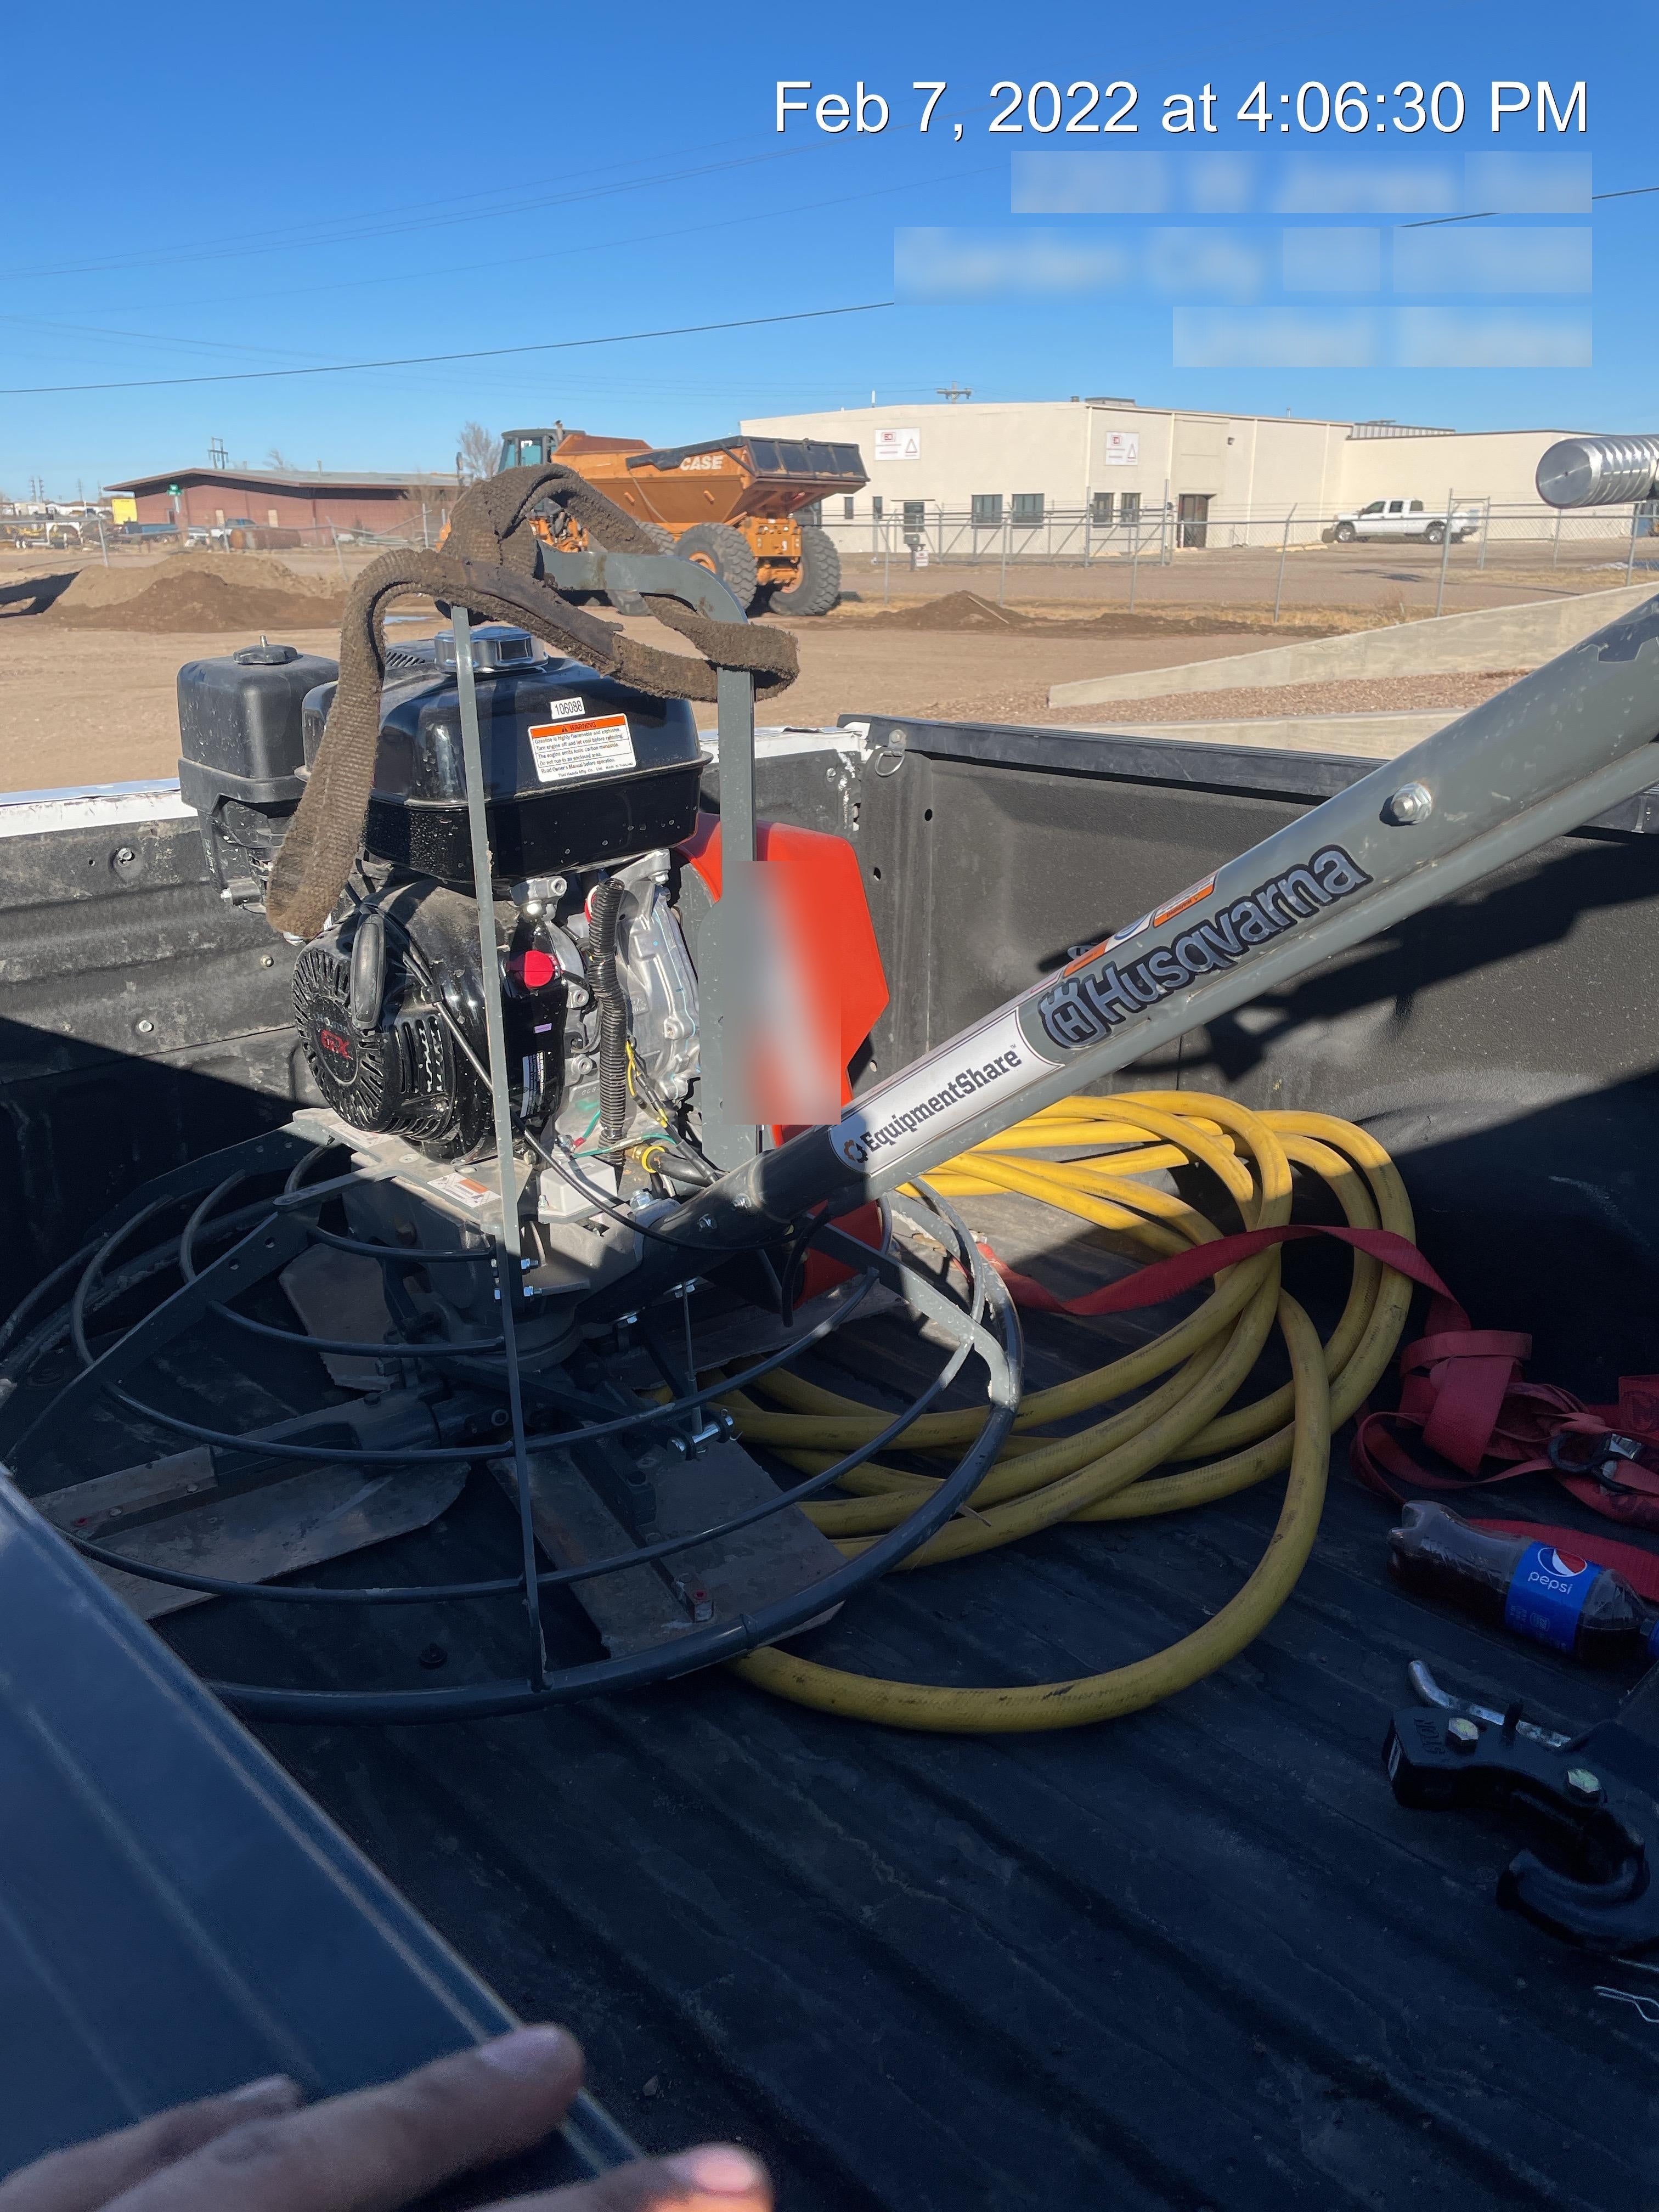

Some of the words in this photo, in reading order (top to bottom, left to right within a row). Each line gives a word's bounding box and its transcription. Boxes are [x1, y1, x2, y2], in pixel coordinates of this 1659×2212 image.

[680, 455, 724, 471] CASE
[555, 700, 583, 715] 106088
[570, 721, 596, 731] WARNING
[1083, 845, 1372, 1025] Husqvarna
[860, 1049, 1022, 1152] EquipmentShare
[1527, 1571, 1574, 1595] pepsi
